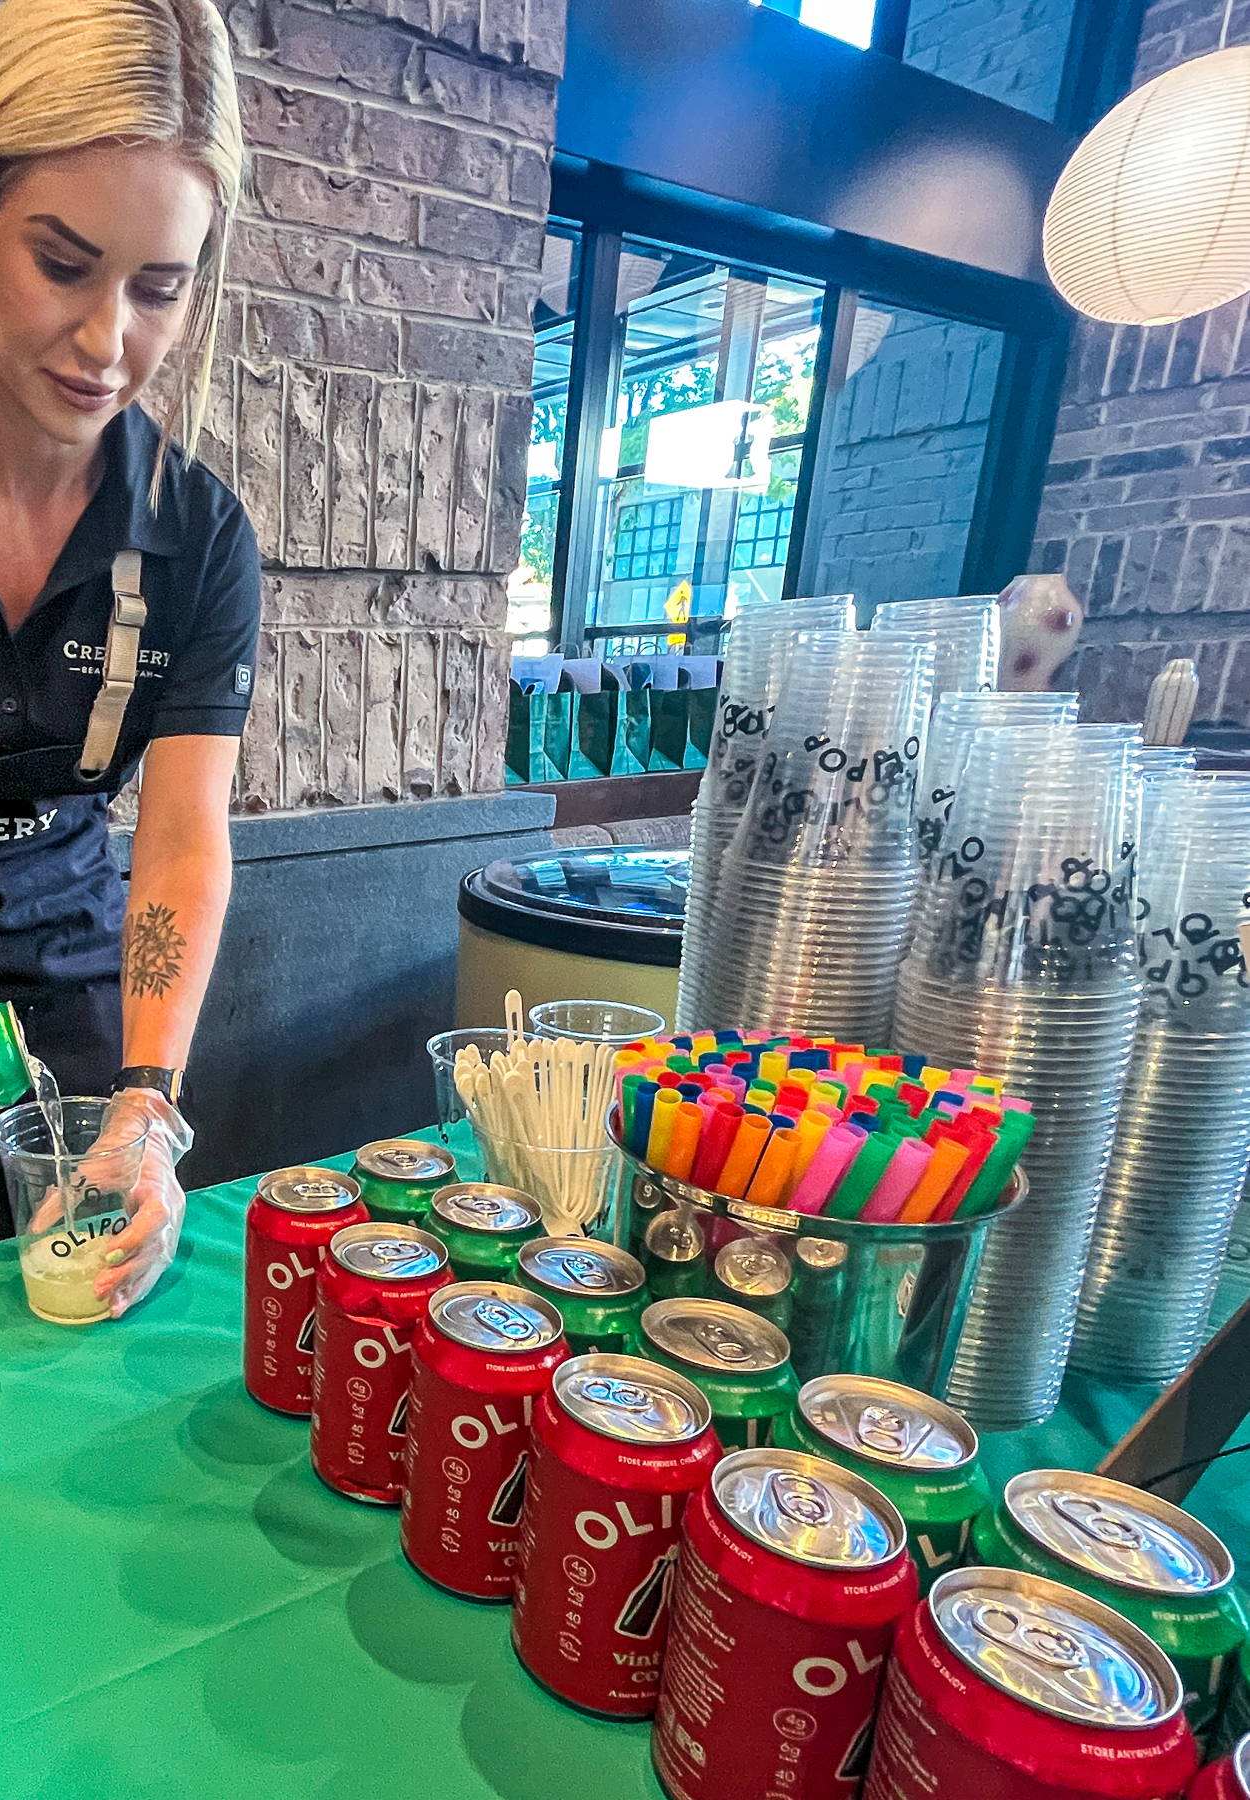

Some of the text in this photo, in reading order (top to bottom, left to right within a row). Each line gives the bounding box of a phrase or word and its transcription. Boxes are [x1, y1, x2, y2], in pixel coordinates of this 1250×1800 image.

[63, 640, 171, 667] CREERY
[449, 1461, 464, 1476] 4g
[447, 1484, 462, 1499] 6g
[445, 1508, 460, 1519] 40
[571, 1561, 587, 1577] 4g
[568, 1586, 584, 1602] 6g
[565, 1611, 581, 1625] 40
[786, 1714, 806, 1730] 4g
[780, 1742, 801, 1758] 6g
[1080, 1743, 1116, 1760] STORE
[775, 1770, 795, 1783] 40
